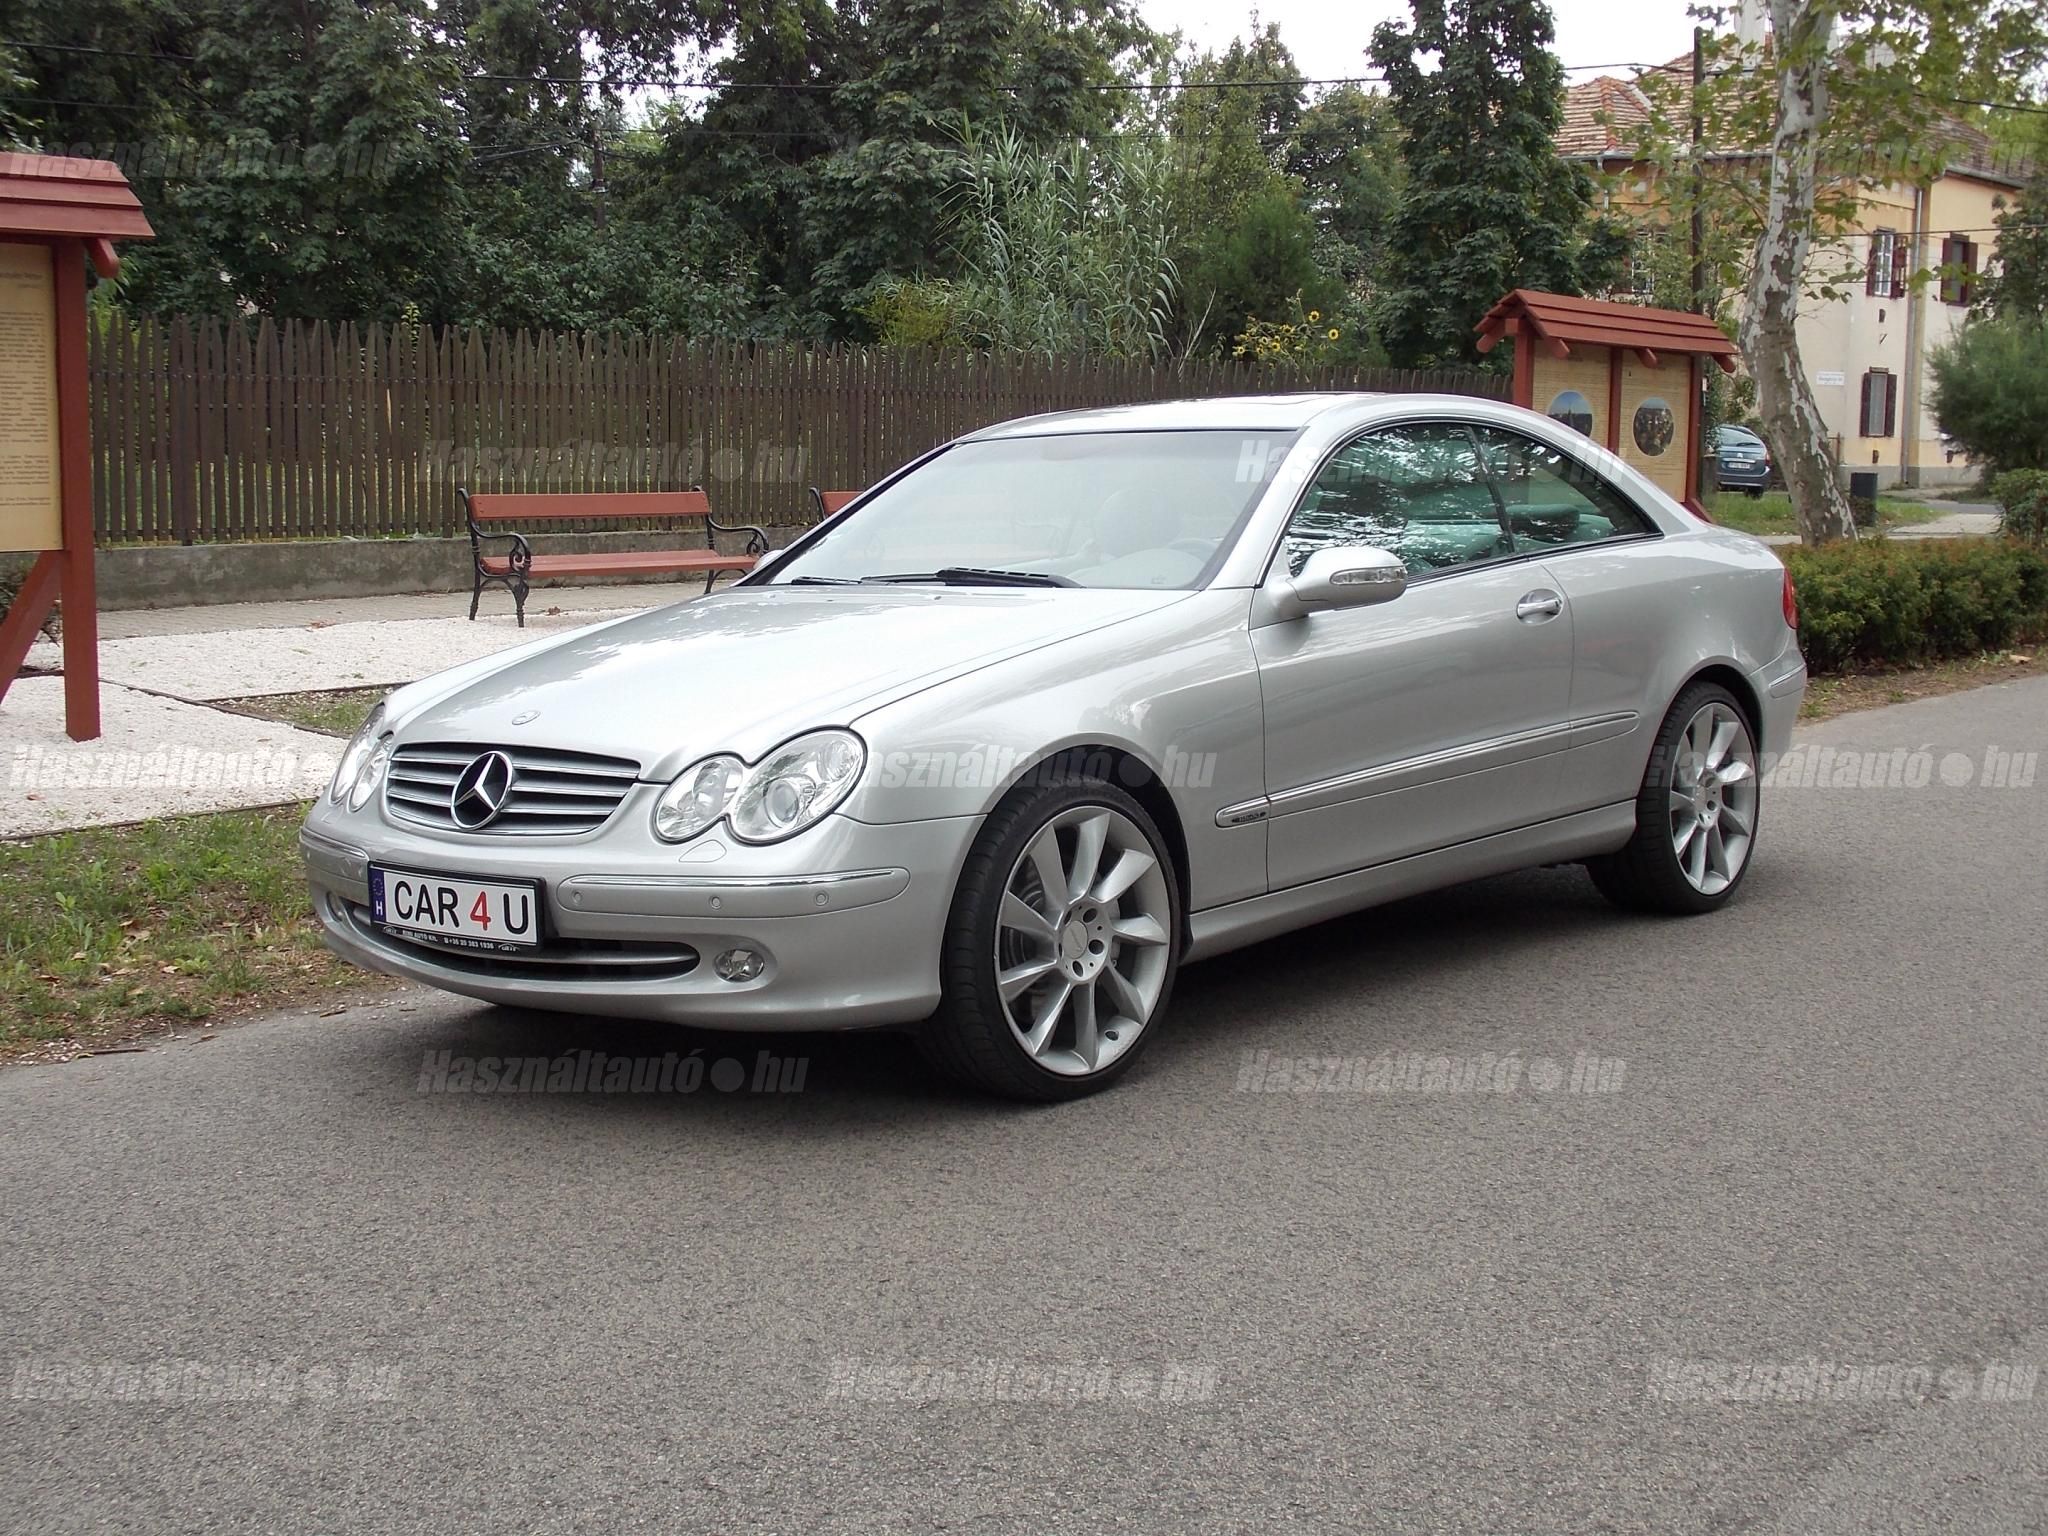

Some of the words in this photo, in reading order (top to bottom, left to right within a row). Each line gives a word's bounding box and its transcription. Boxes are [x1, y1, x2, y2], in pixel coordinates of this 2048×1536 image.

[376, 900, 383, 916] H
[394, 880, 460, 928] CAR
[470, 890, 491, 931] 4
[503, 893, 529, 935] U
